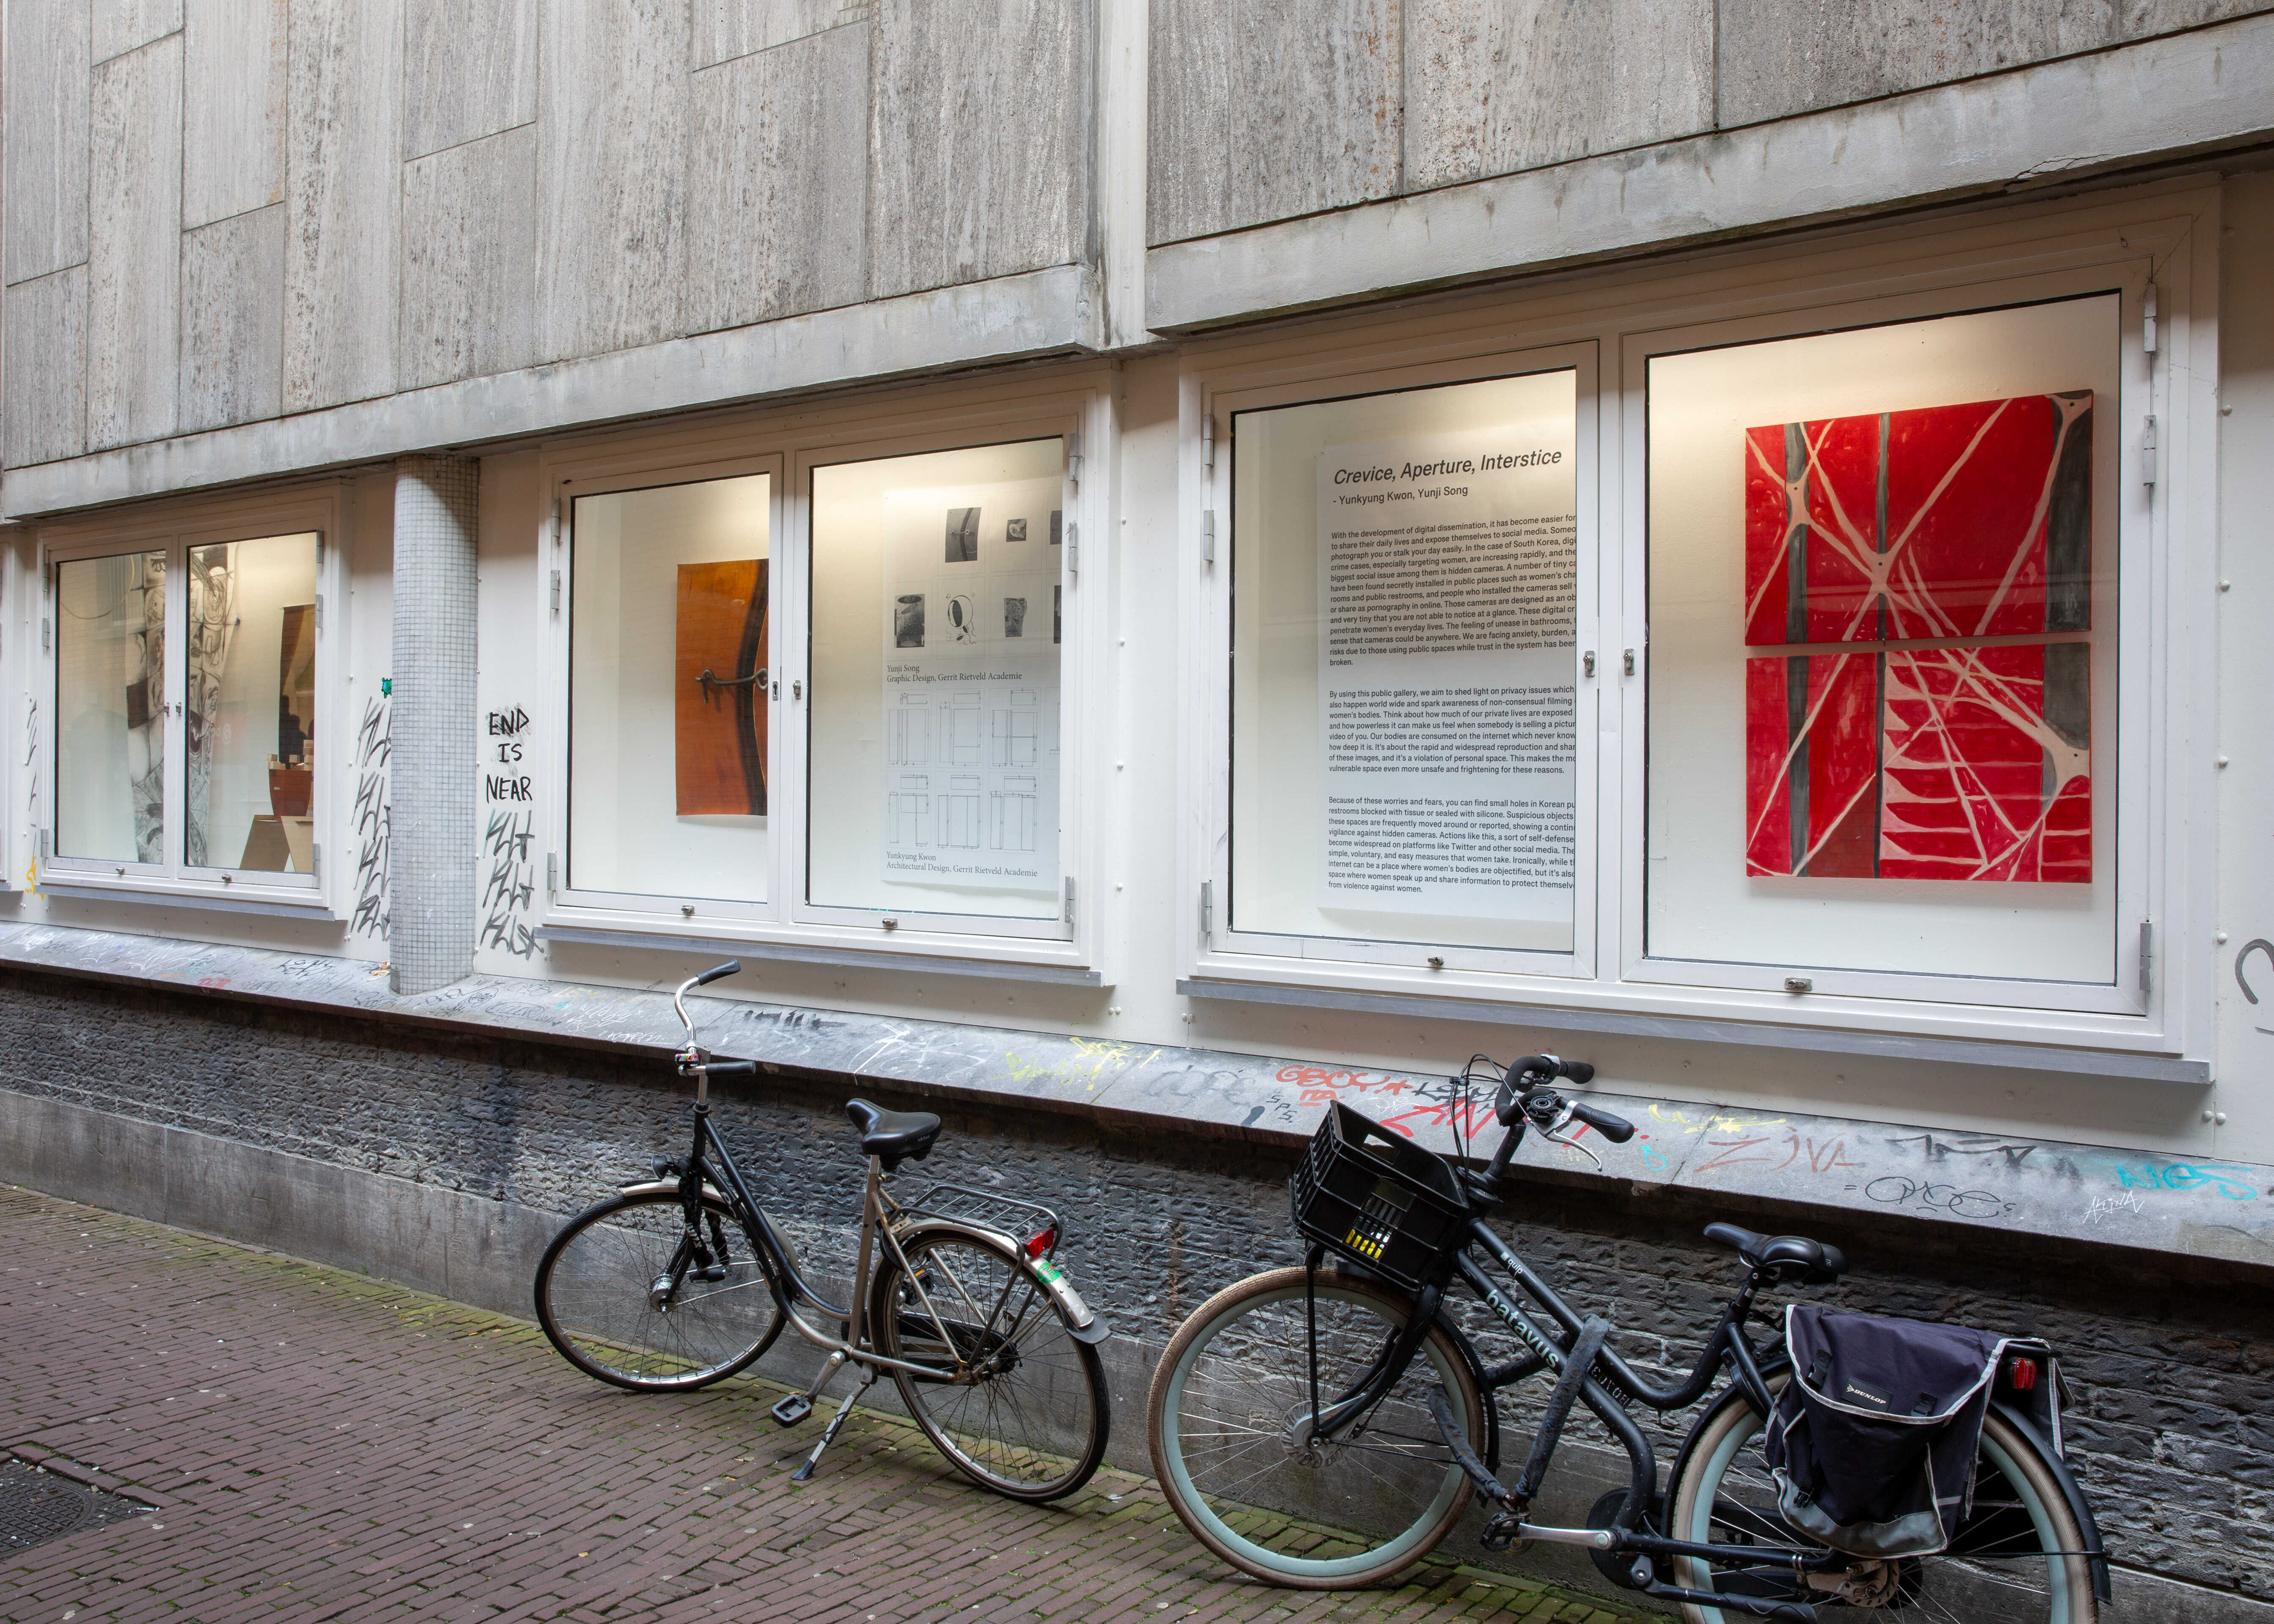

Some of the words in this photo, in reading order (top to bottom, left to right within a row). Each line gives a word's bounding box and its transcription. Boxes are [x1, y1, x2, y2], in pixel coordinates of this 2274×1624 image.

[1335, 466, 1395, 484] Crevice,
[1400, 460, 1475, 481] Aperture,
[1481, 450, 1561, 470] Interstice
[1339, 494, 1384, 505] Yunkyung
[1387, 491, 1414, 501] Kwon,
[1418, 487, 1440, 499] Yunji
[1444, 487, 1467, 496] Song
[1361, 528, 1404, 537] development
[1414, 525, 1436, 535] digital
[1438, 521, 1488, 531] dissemination,
[1541, 515, 1563, 523] easier
[1331, 551, 1368, 562] photograph
[1412, 549, 1426, 557] your
[1428, 547, 1440, 555] day
[1442, 545, 1464, 554] easily.
[1513, 540, 1534, 548] South
[1373, 560, 1406, 569] especially
[1408, 558, 1439, 567] targeting
[1483, 552, 1518, 561] increasing
[1520, 550, 1547, 560] rapidly,
[1359, 615, 1372, 623] tiny
[1492, 609, 1516, 618] glance.
[1542, 606, 1565, 615] digital
[887, 665, 902, 673] Yunji
[904, 665, 919, 673] Song
[887, 675, 910, 684] Graphic
[913, 675, 936, 683] Design,
[1330, 691, 1337, 699] By
[1339, 691, 1356, 699] using
[1371, 690, 1392, 698] public
[1393, 689, 1418, 698] gallery,
[1473, 688, 1489, 697] light
[1501, 687, 1527, 696] privacy
[1485, 710, 1509, 719] private
[1542, 708, 1572, 717] exposed
[490, 709, 529, 735] END
[499, 743, 522, 762] IS
[1461, 765, 1499, 774] frightening
[487, 775, 532, 803] NEAR
[1507, 811, 1545, 820] Suspicious
[1547, 812, 1573, 821] objects
[1329, 828, 1355, 837] vigilance
[1357, 829, 1380, 837] against
[1529, 834, 1574, 842] self-defense
[887, 852, 917, 862] Yunkyung
[887, 861, 926, 870] Architectural
[928, 864, 951, 873] Design,
[975, 866, 1001, 874] Rietveld
[1004, 868, 1037, 876] Academie
[1370, 884, 1395, 892] against
[1486, 1289, 1559, 1368] batavus
[1854, 1389, 1887, 1404] DUNLOP
